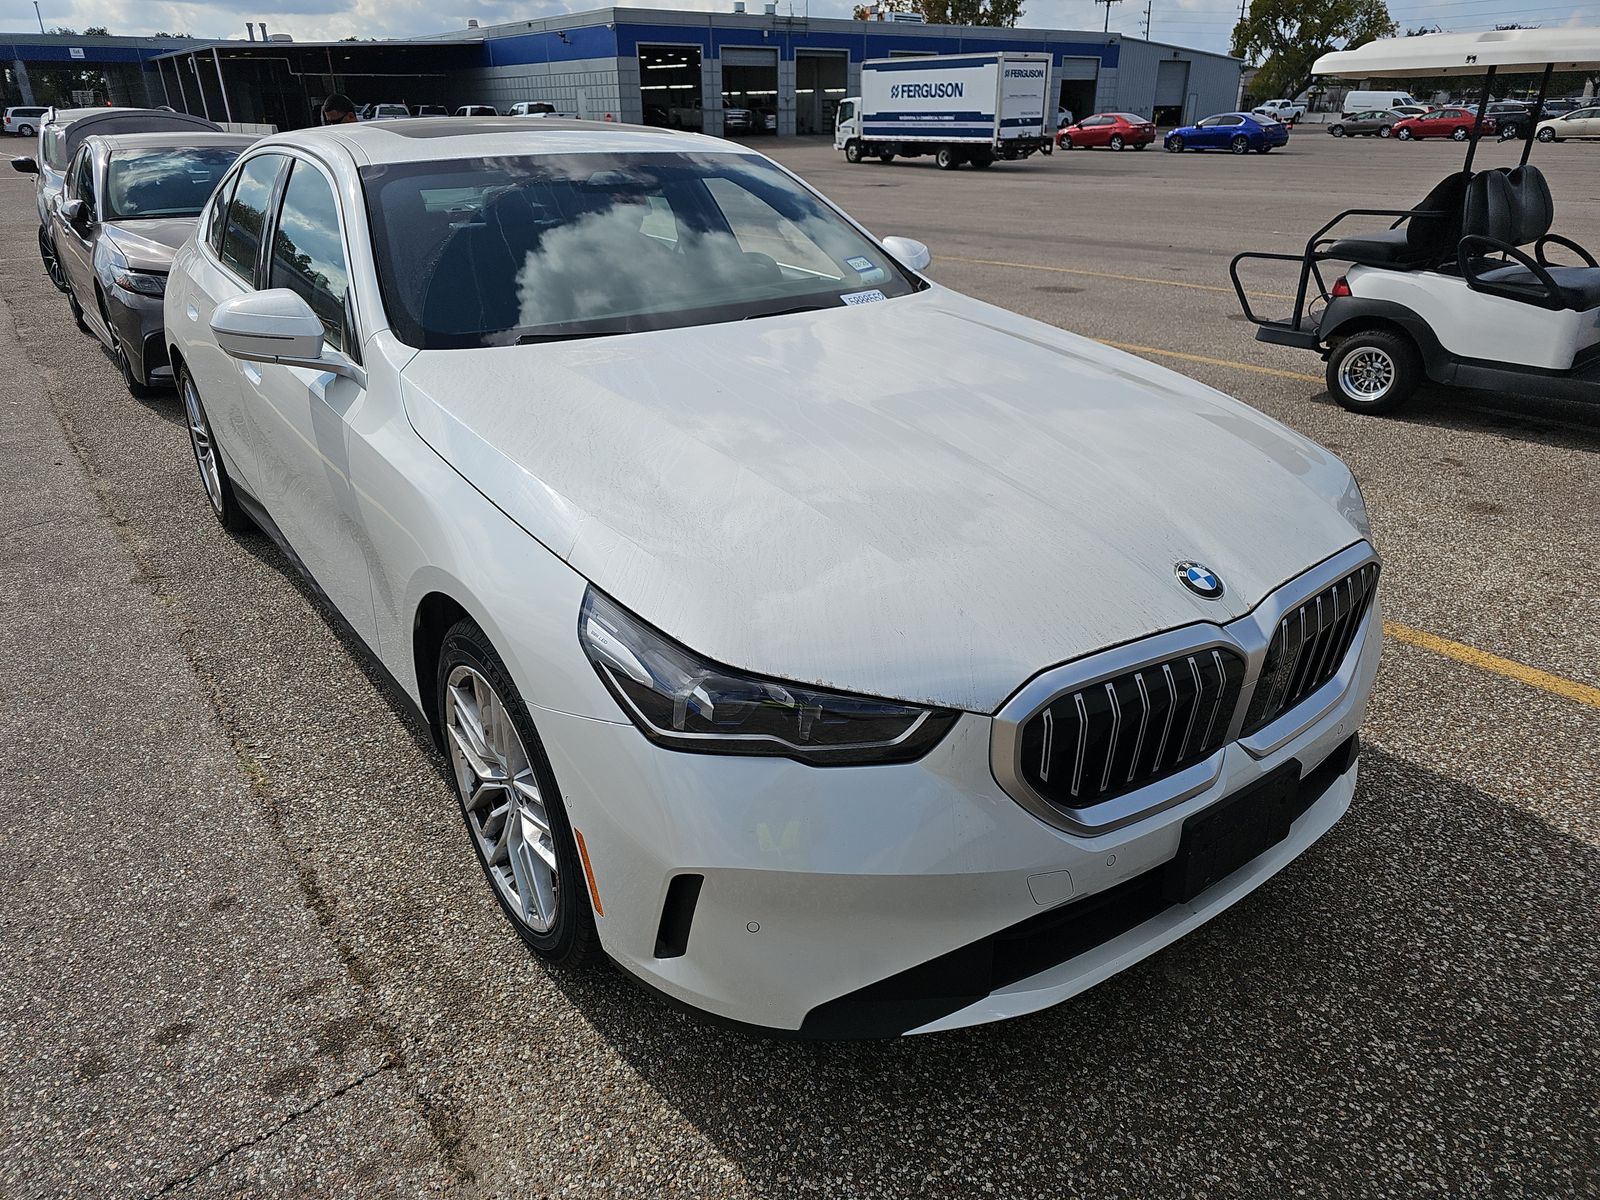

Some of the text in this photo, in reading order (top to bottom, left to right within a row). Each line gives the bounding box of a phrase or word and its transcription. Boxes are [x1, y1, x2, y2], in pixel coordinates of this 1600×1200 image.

[1011, 69, 1044, 78] FERGUSON
[901, 83, 964, 99] FERGUSON
[480, 655, 533, 744] IRONMAN
